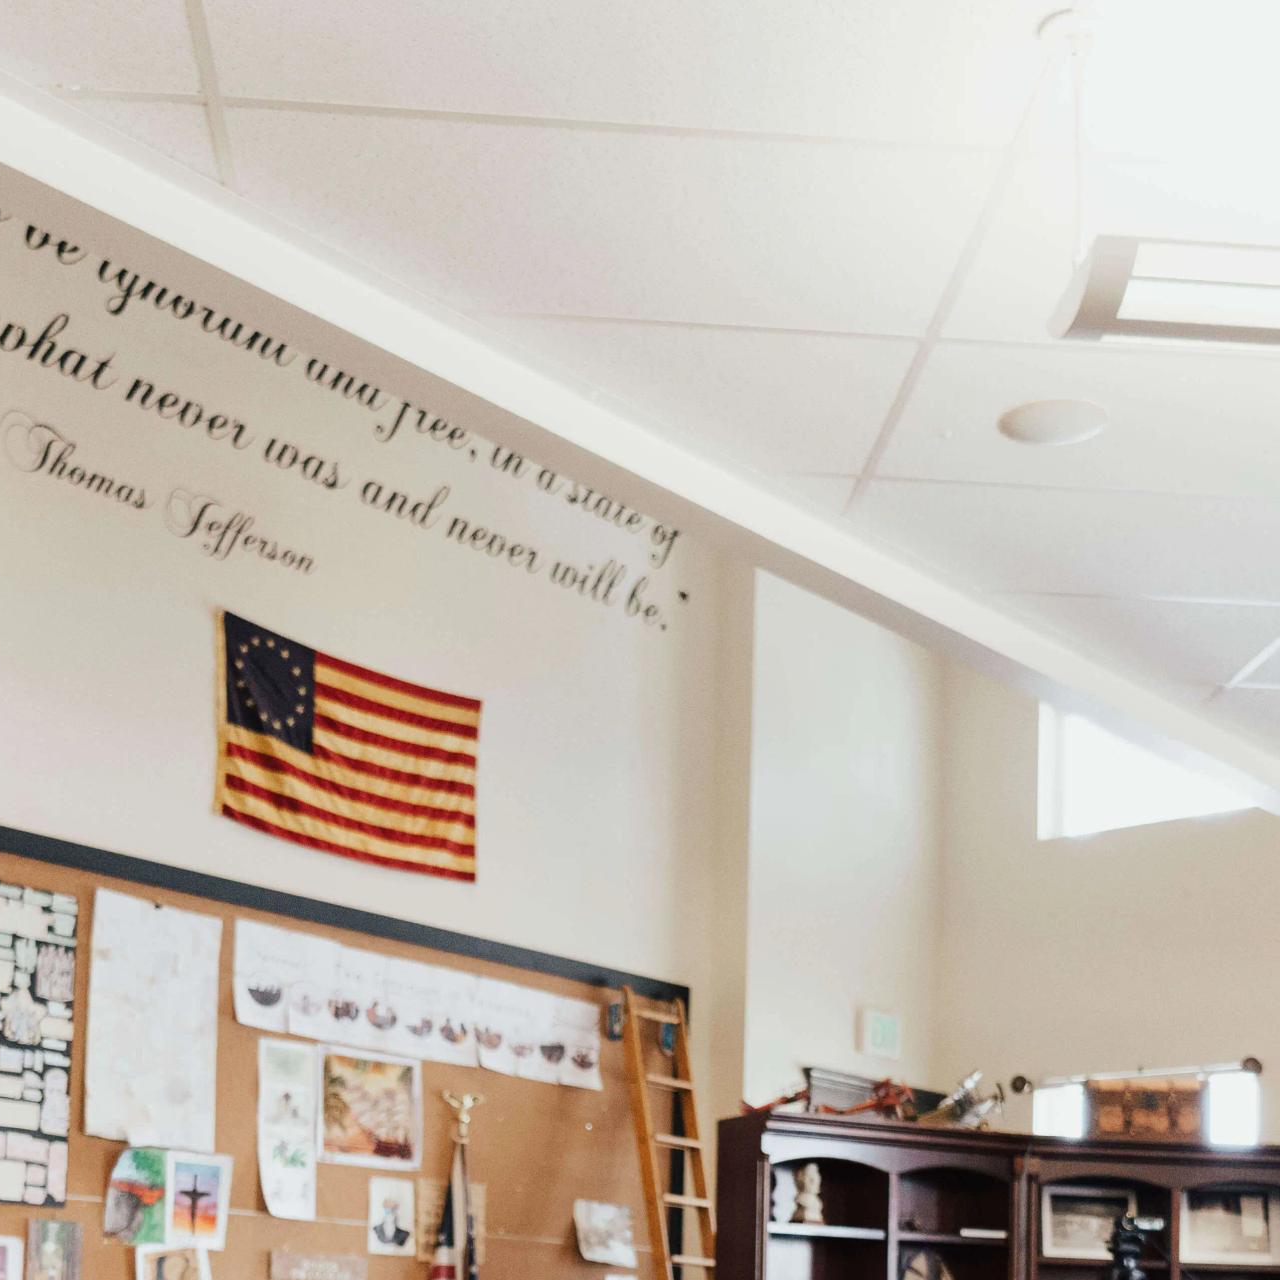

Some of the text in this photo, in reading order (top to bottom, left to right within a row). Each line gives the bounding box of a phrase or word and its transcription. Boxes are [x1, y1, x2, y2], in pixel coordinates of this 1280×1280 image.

[0, 408, 157, 510] Thomas
[164, 486, 318, 577] Jefferson
[125, 377, 255, 450] never
[263, 438, 352, 490] was
[360, 481, 451, 530] and
[446, 516, 545, 575] never
[549, 558, 627, 607] will
